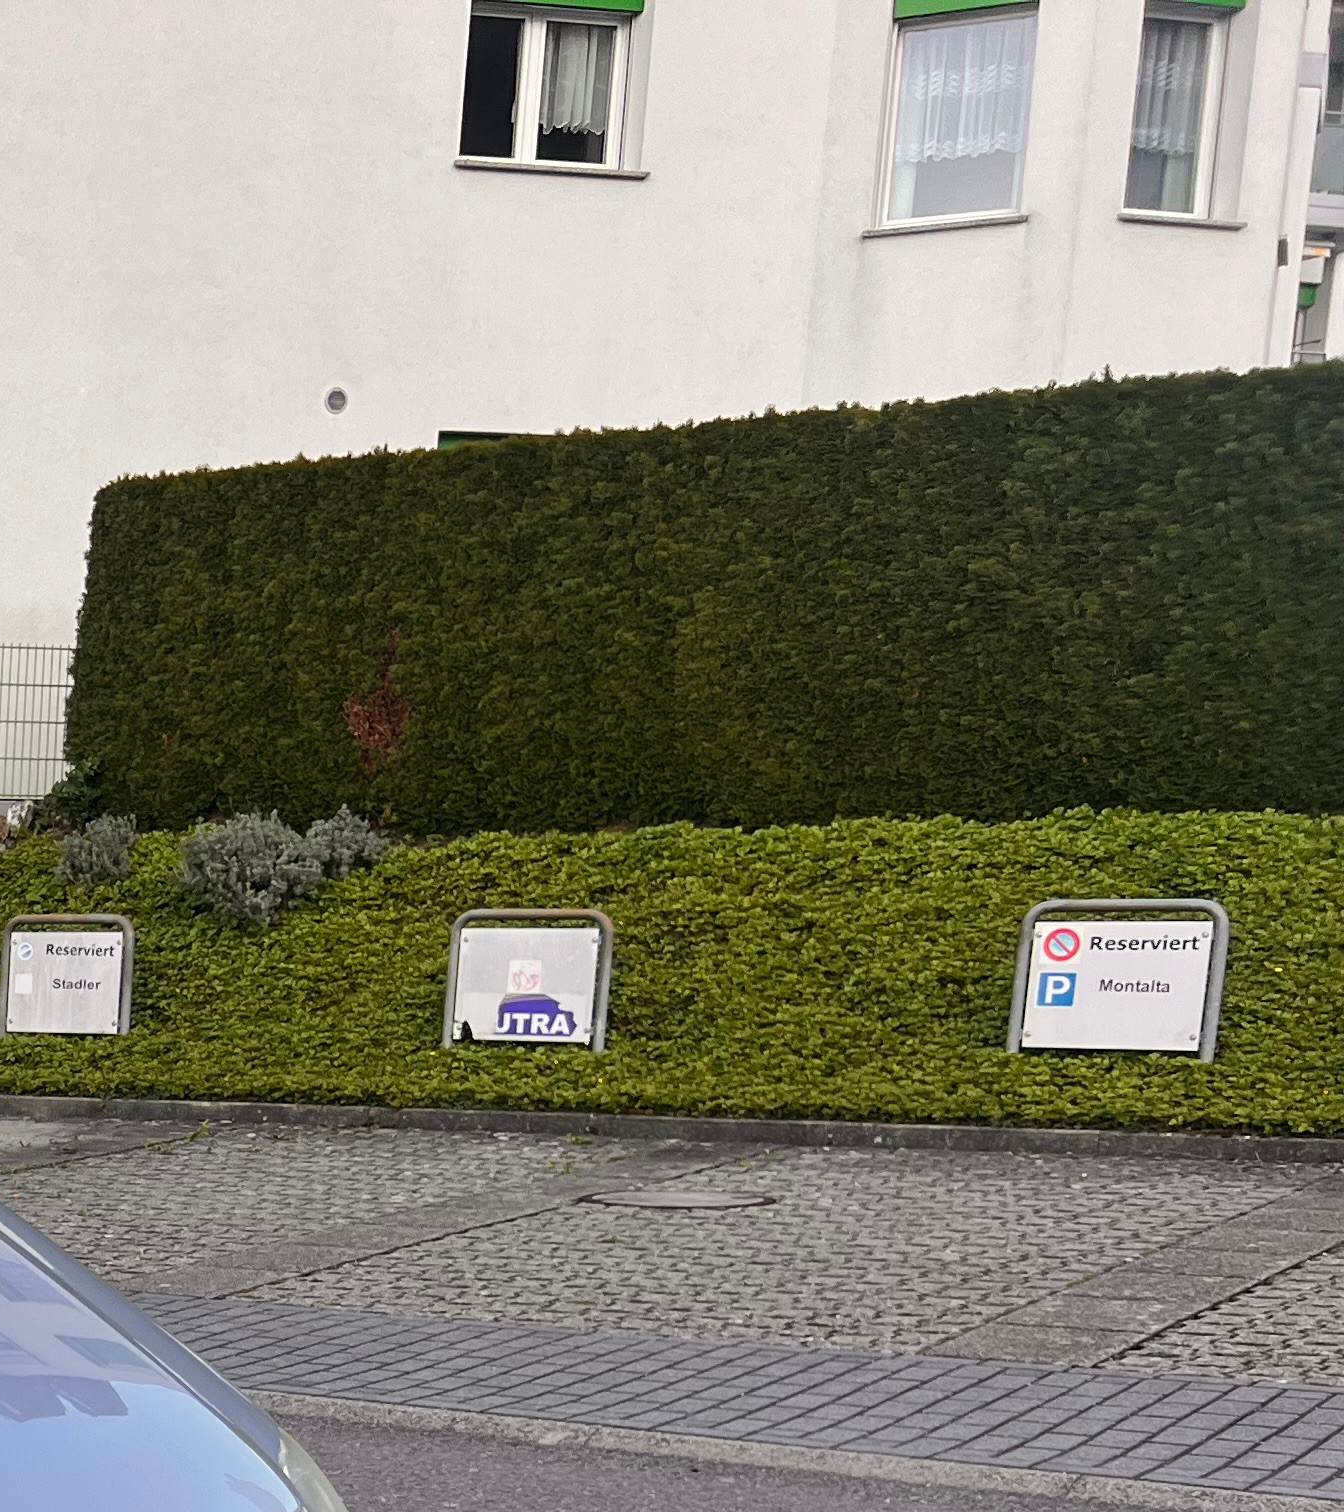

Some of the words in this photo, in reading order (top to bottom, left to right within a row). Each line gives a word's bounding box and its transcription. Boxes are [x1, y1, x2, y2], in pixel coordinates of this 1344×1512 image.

[45, 943, 115, 957] Reserviert
[1090, 935, 1200, 951] Reserviert
[52, 978, 101, 990] Stadler
[1044, 976, 1071, 1004] P
[1099, 978, 1171, 993] Montalta
